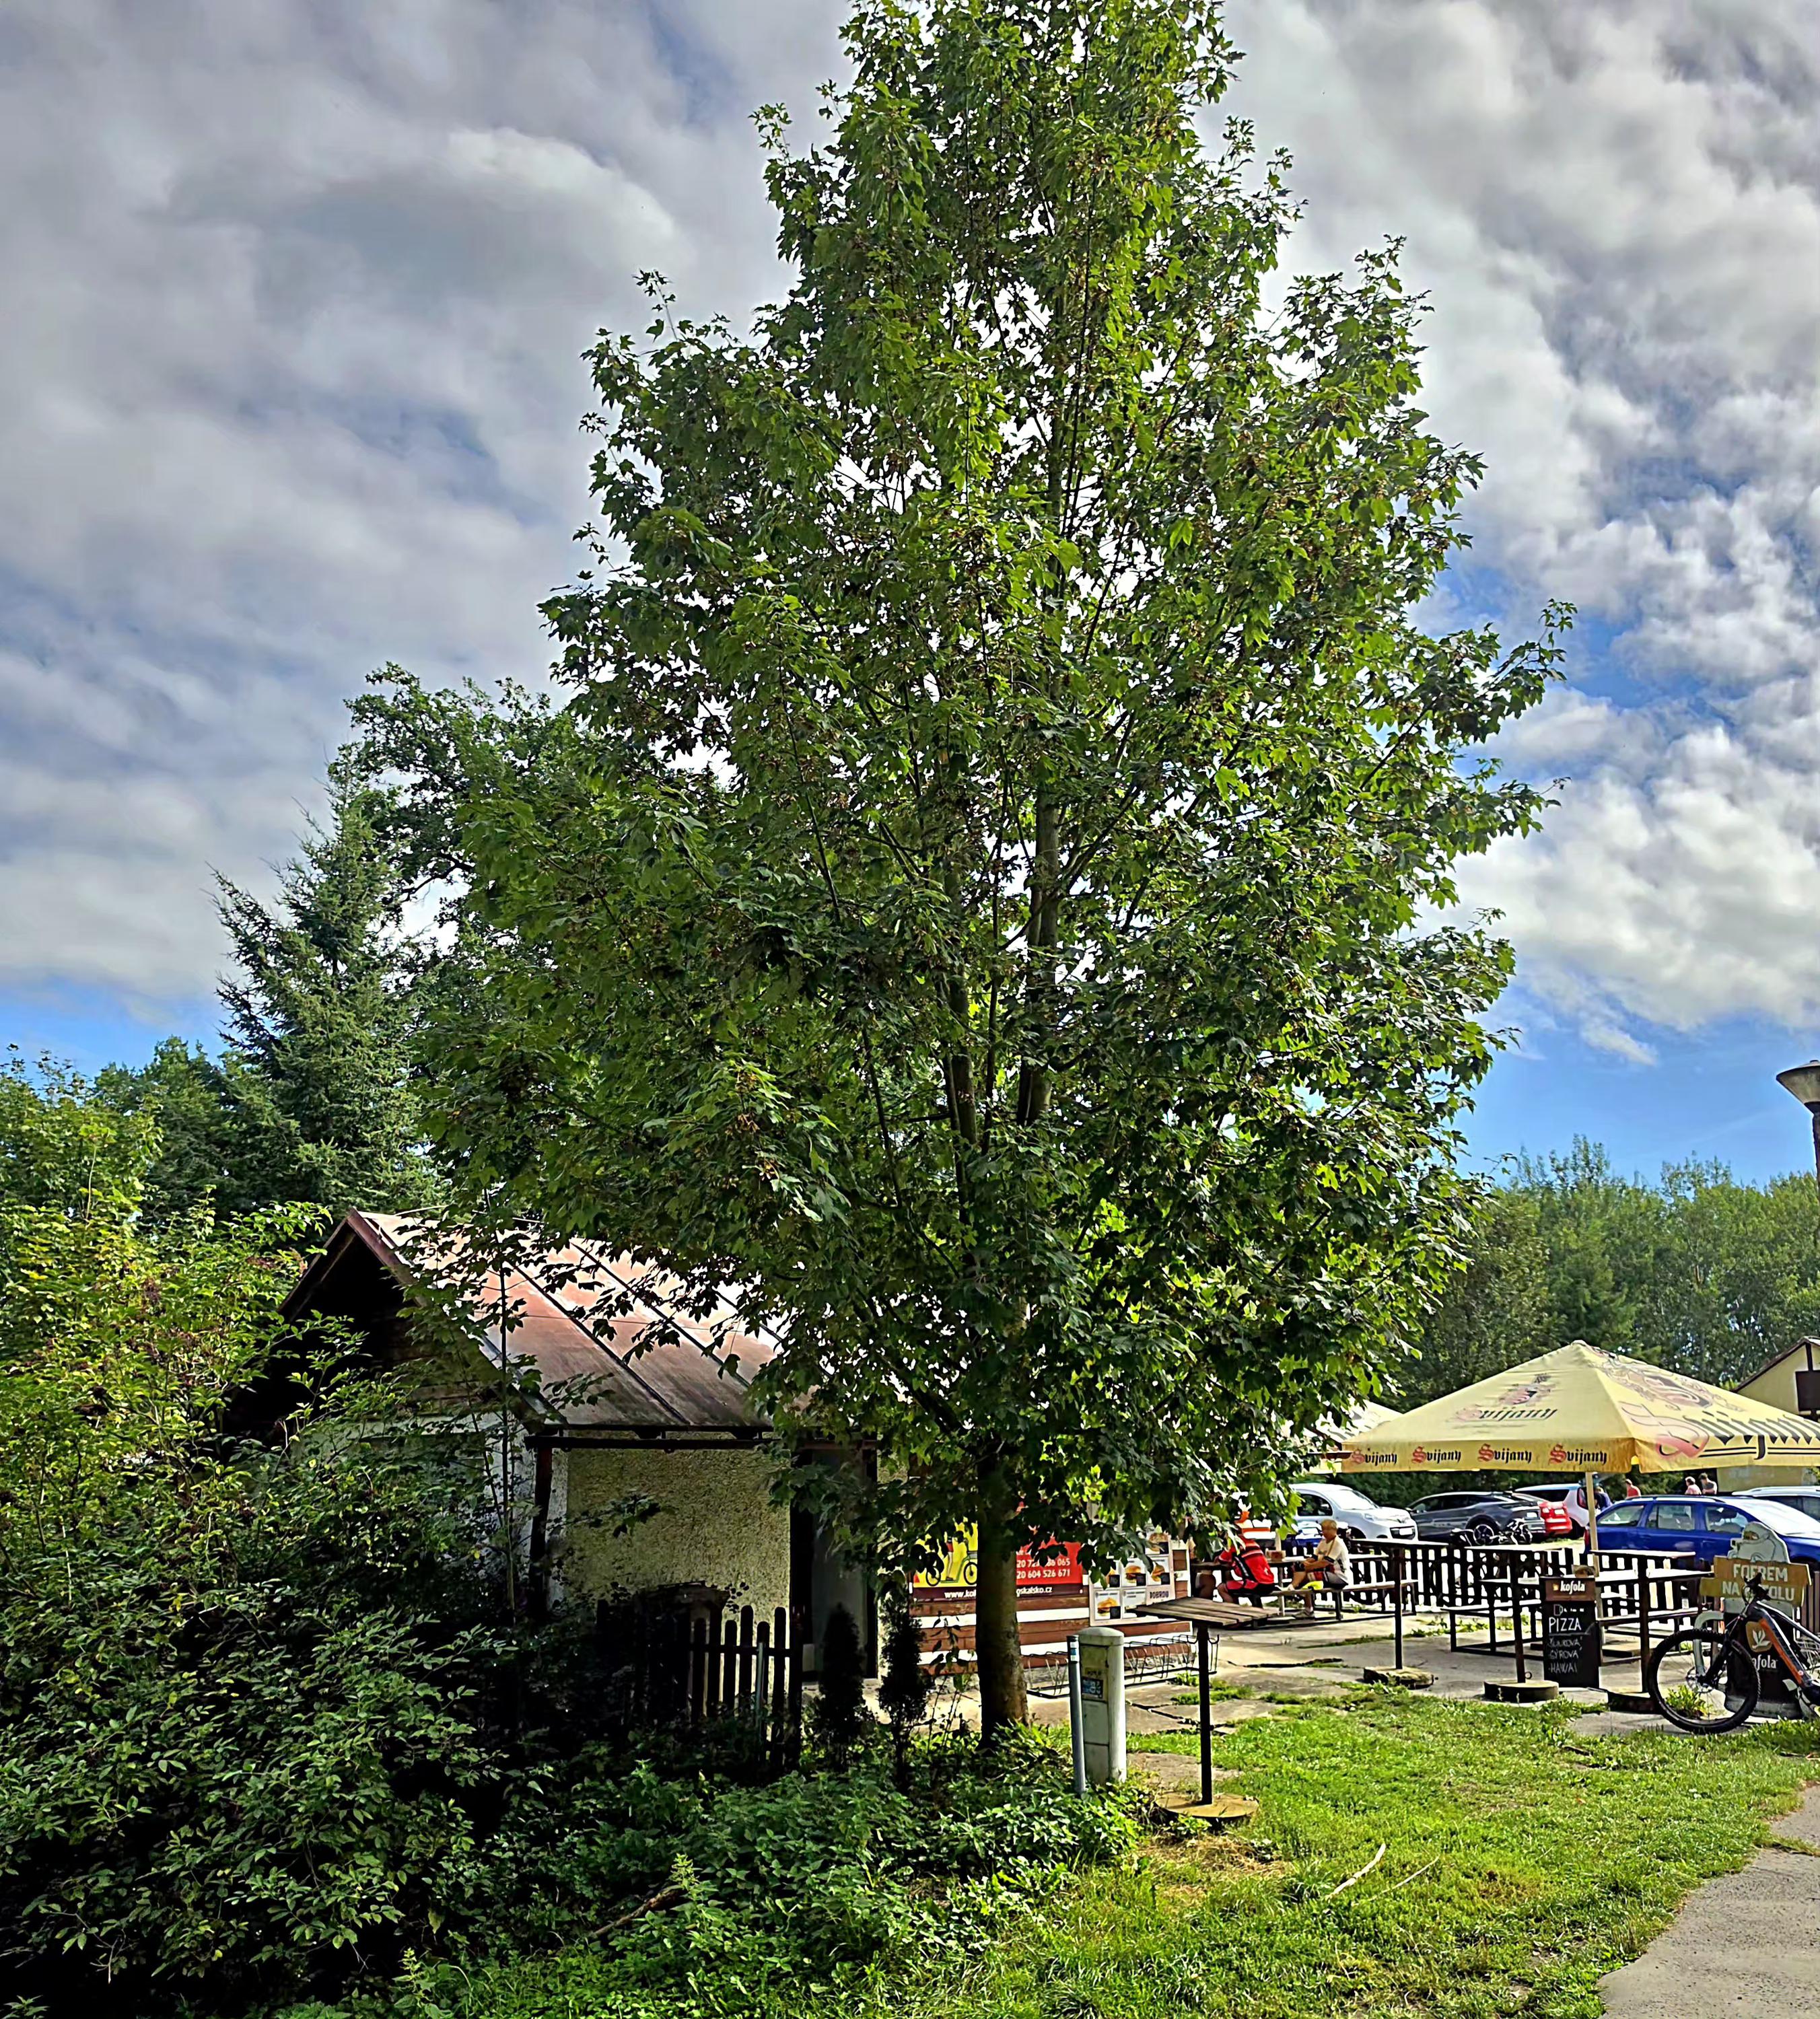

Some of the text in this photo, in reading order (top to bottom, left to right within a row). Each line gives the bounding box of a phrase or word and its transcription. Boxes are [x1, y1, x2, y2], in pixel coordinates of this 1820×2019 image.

[1350, 1448, 1397, 1464] Svijany
[1412, 1445, 1461, 1464] Svijany
[1478, 1443, 1532, 1464] Svijany
[1549, 1443, 1607, 1464] Svijany
[1016, 1560, 1026, 1568] 20
[1057, 1558, 1071, 1567] 065
[1016, 1569, 1071, 1579] 20 604 526 671
[1560, 1580, 1585, 1594] kofola
[1722, 1581, 1741, 1596] NA
[1549, 1617, 1582, 1633] PIZZA
[1751, 1654, 1777, 1670] ofola
